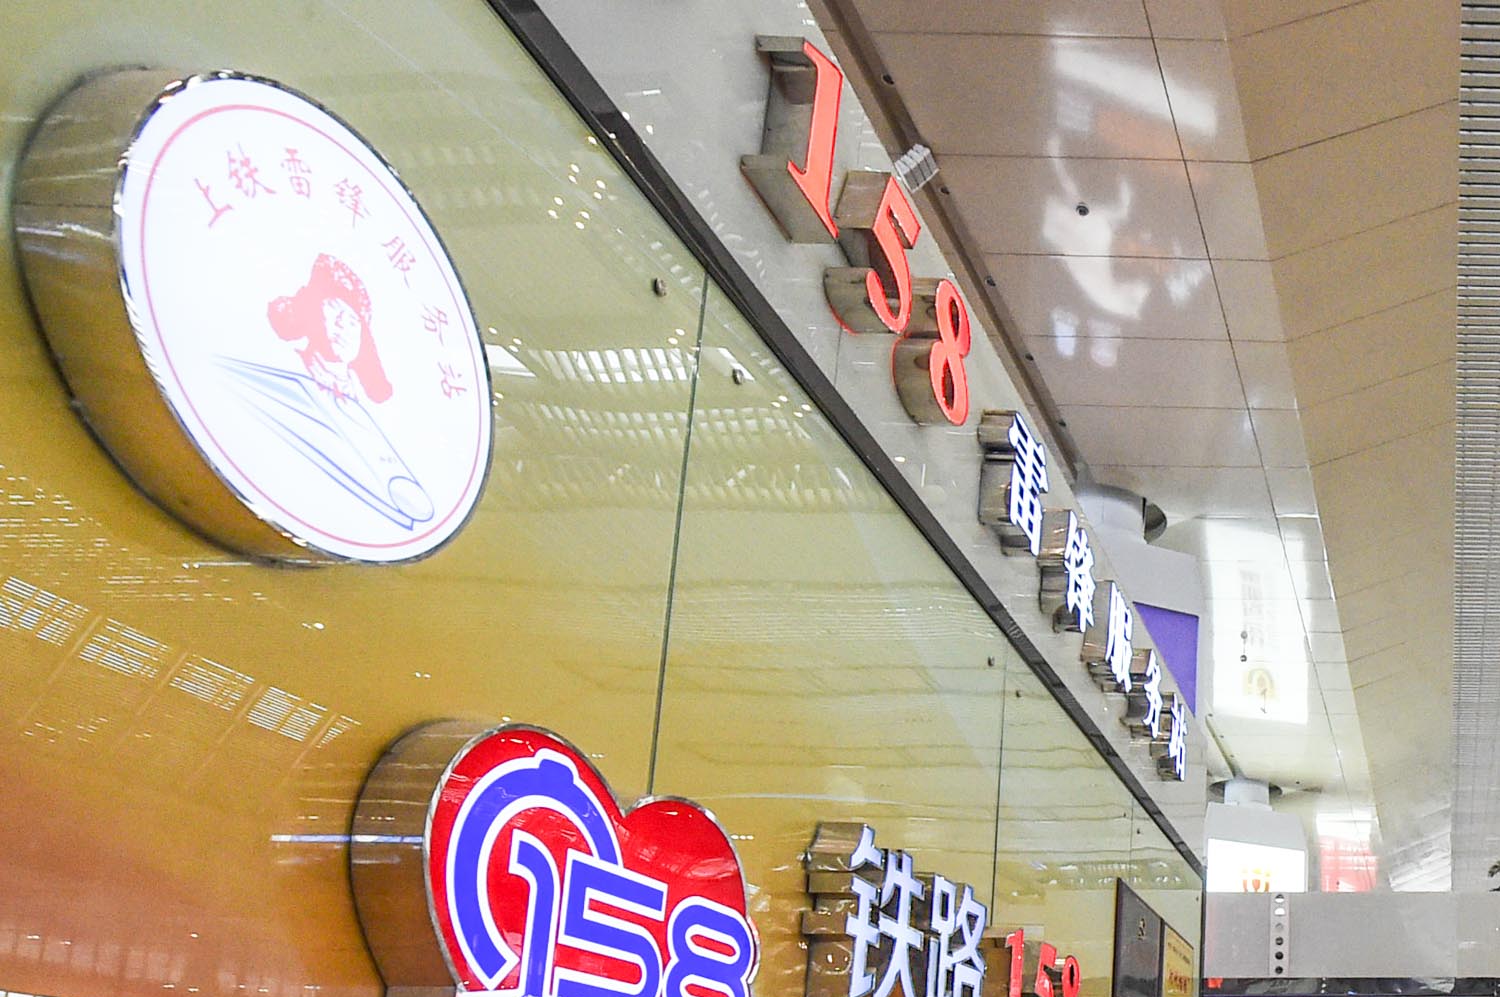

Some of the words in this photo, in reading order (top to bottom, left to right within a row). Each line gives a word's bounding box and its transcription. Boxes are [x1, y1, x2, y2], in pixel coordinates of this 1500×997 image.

[194, 142, 467, 400] 上铁雷锋服务站
